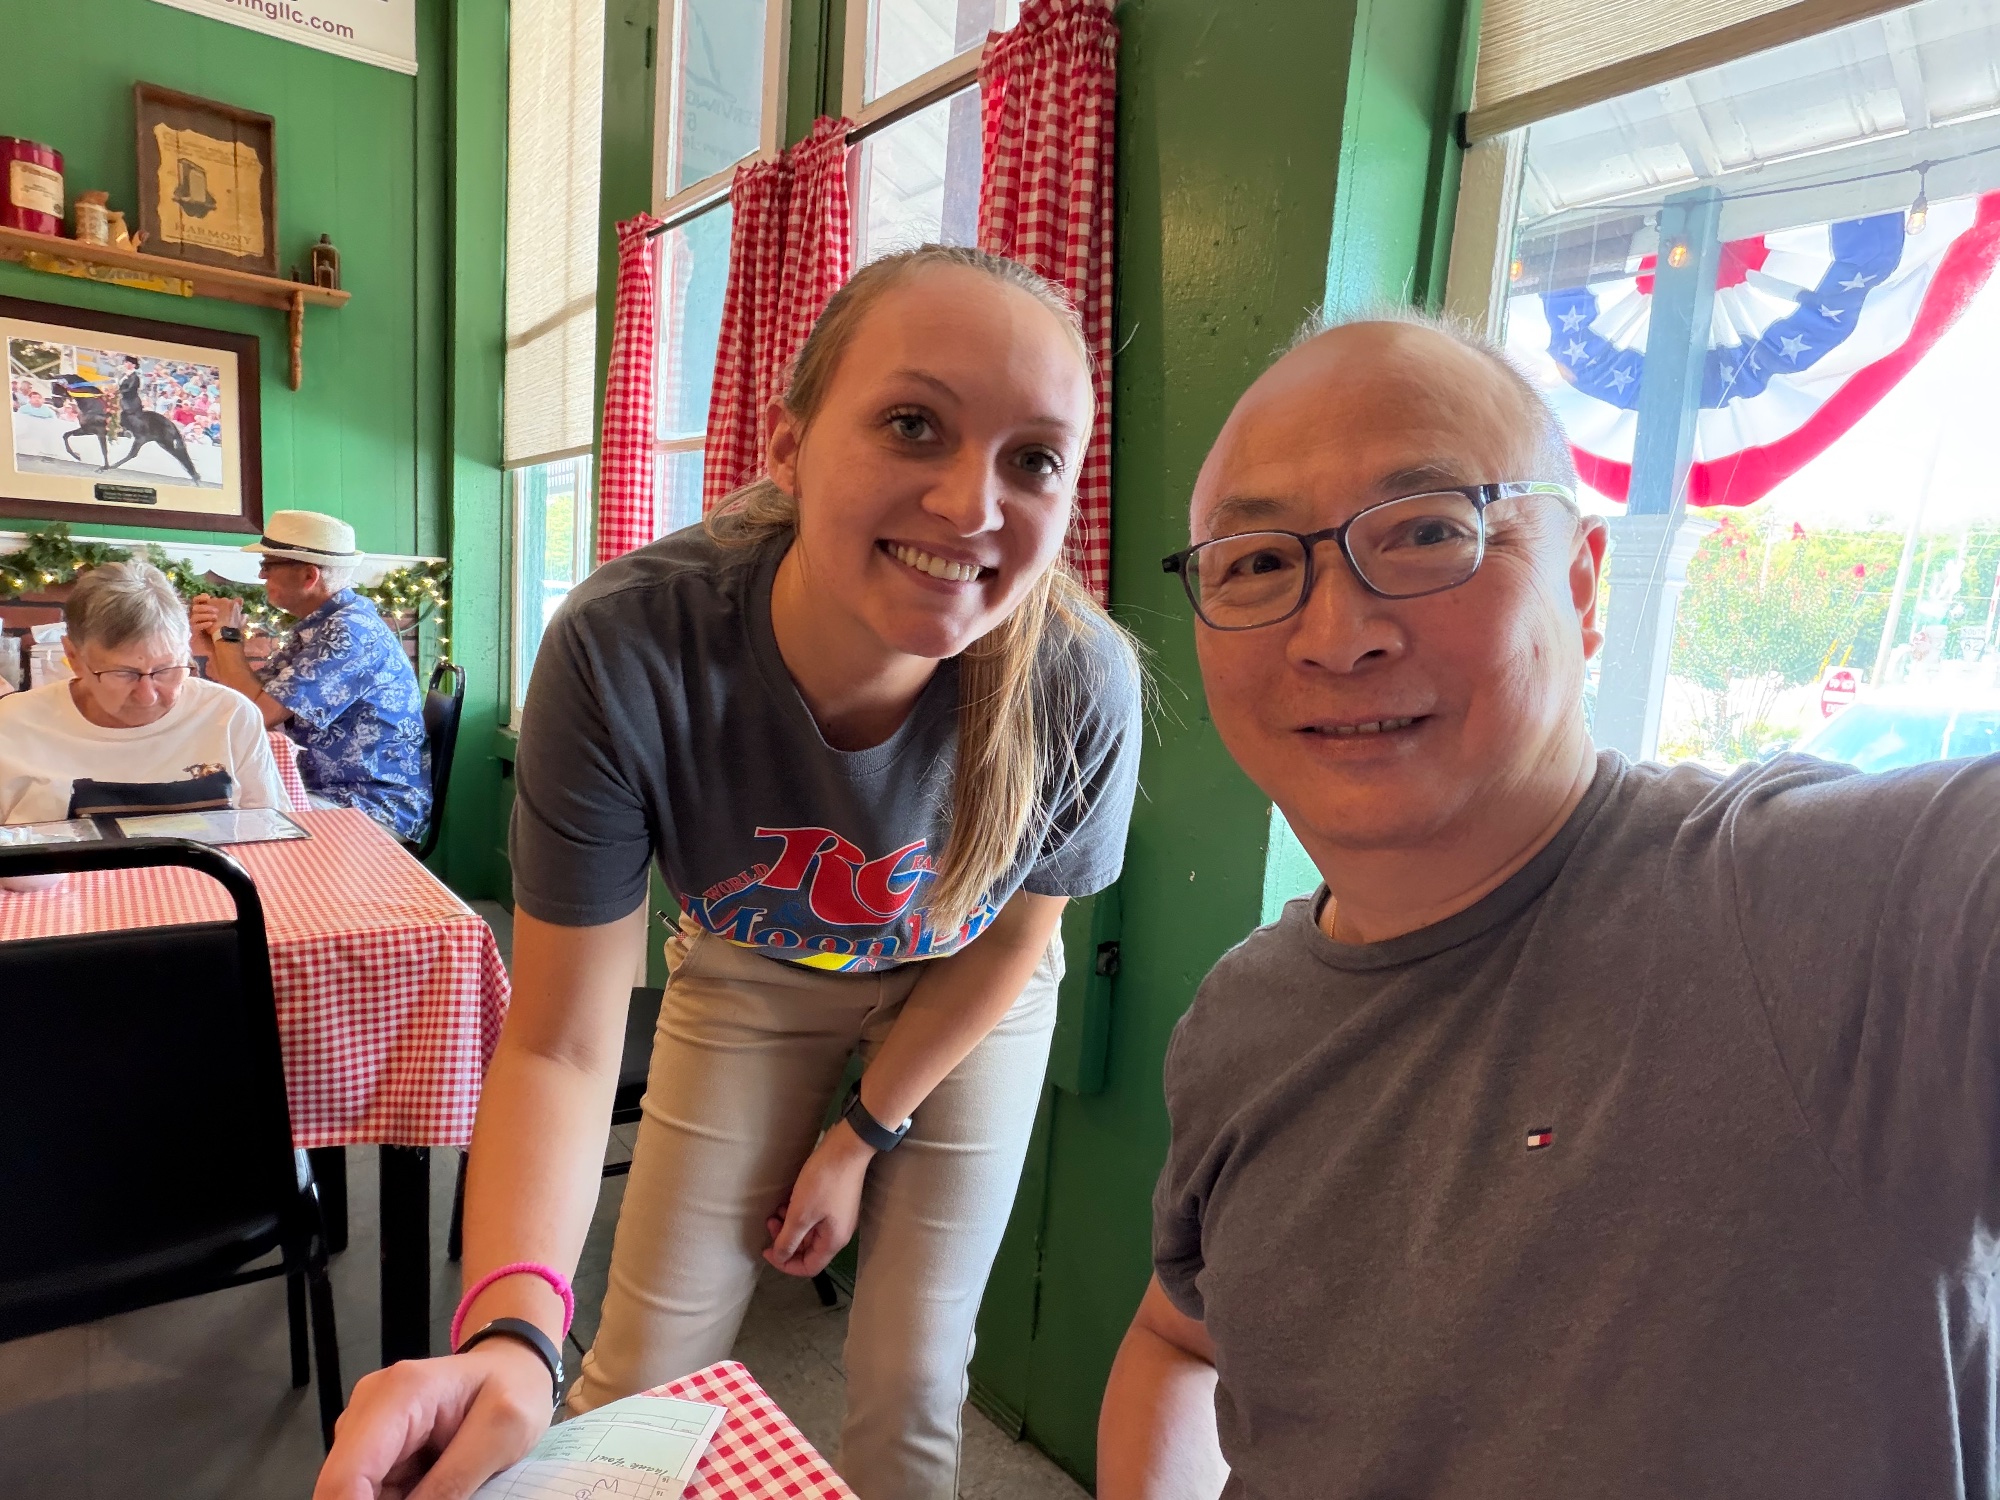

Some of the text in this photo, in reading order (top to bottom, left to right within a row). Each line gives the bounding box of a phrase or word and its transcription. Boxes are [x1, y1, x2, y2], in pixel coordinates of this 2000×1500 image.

[226, 0, 353, 39] ngllc.com
[175, 223, 252, 245] HARMONY
[702, 863, 771, 901] WORLD
